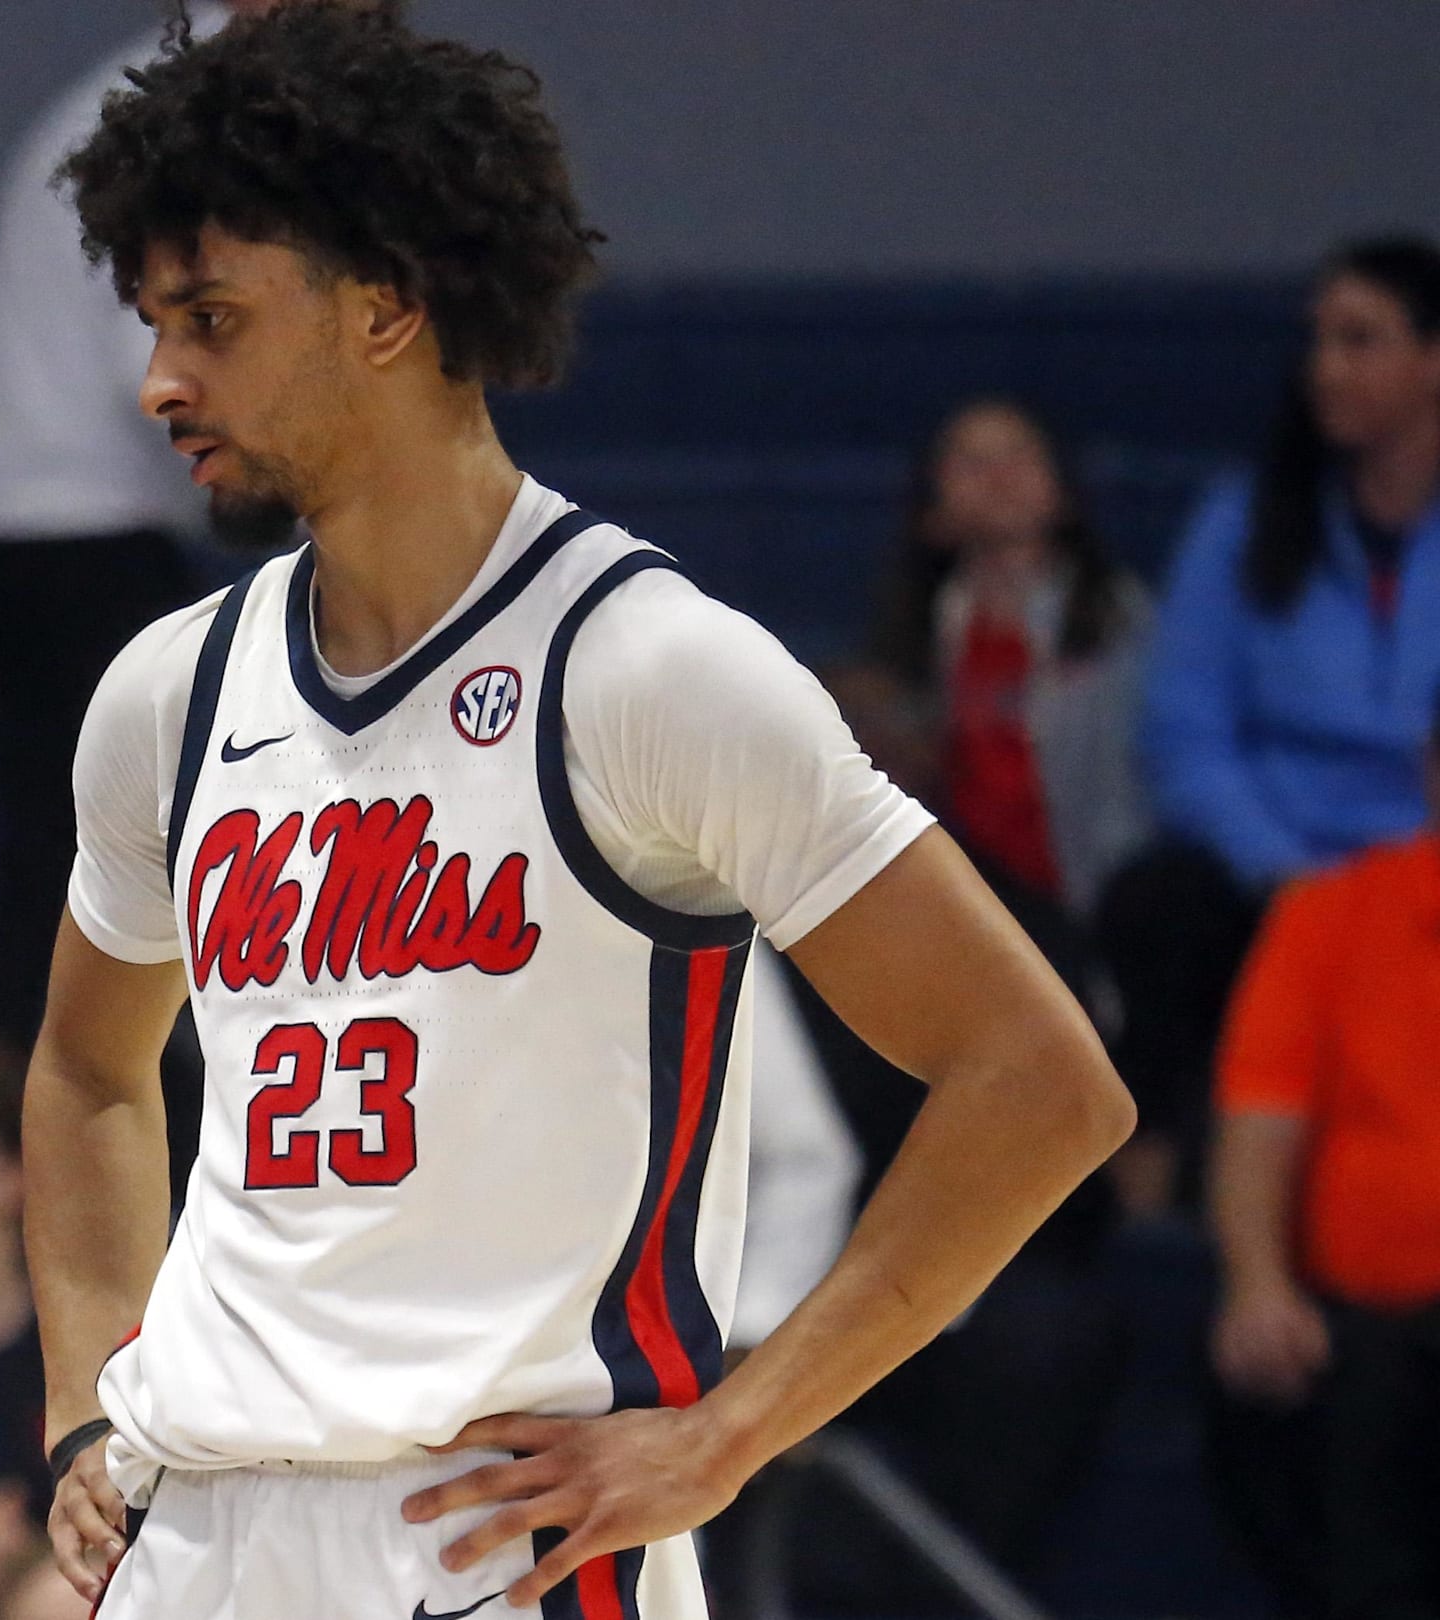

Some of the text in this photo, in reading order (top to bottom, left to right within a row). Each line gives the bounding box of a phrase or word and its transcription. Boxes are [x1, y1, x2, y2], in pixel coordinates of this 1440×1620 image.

[457, 670, 519, 740] SEC
[188, 794, 541, 992] Ole Miss
[243, 1017, 417, 1190] 23
